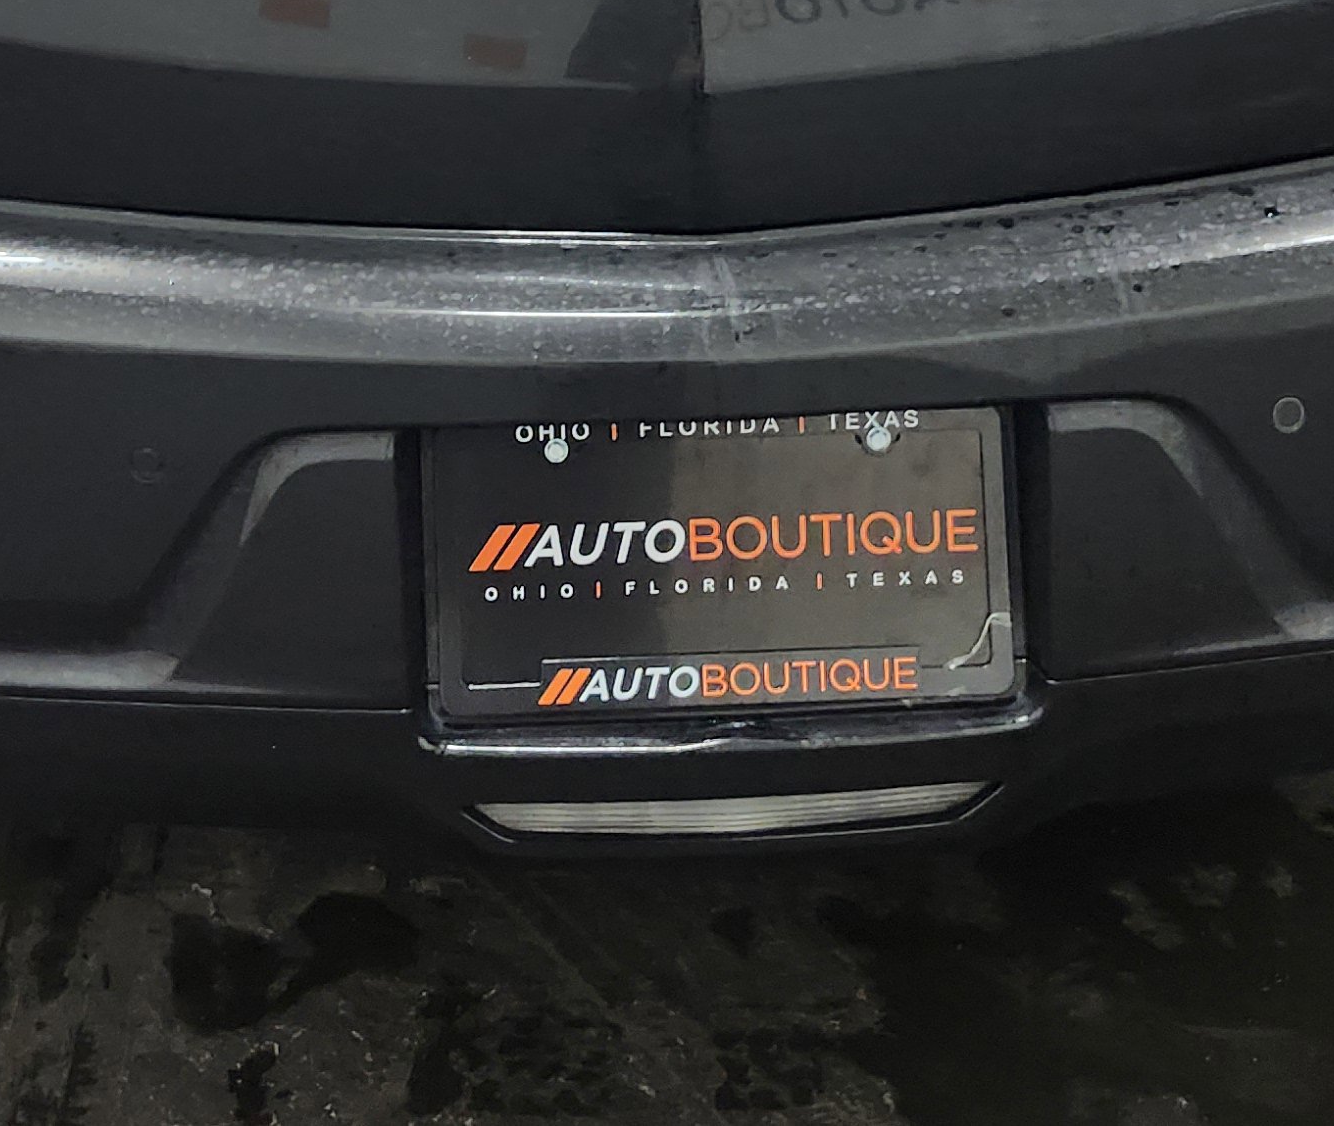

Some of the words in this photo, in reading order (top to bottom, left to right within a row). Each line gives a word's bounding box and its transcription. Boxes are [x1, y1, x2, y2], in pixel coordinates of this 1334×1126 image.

[515, 422, 591, 443] OHIO
[828, 409, 920, 430] TEXAS
[524, 508, 979, 568] AUTOBOUTIQUE
[484, 583, 574, 602] OHIO
[624, 574, 789, 596] FLORIDA
[846, 568, 965, 588] TEXAS
[579, 655, 919, 704] AUTOBOUTIQUE
